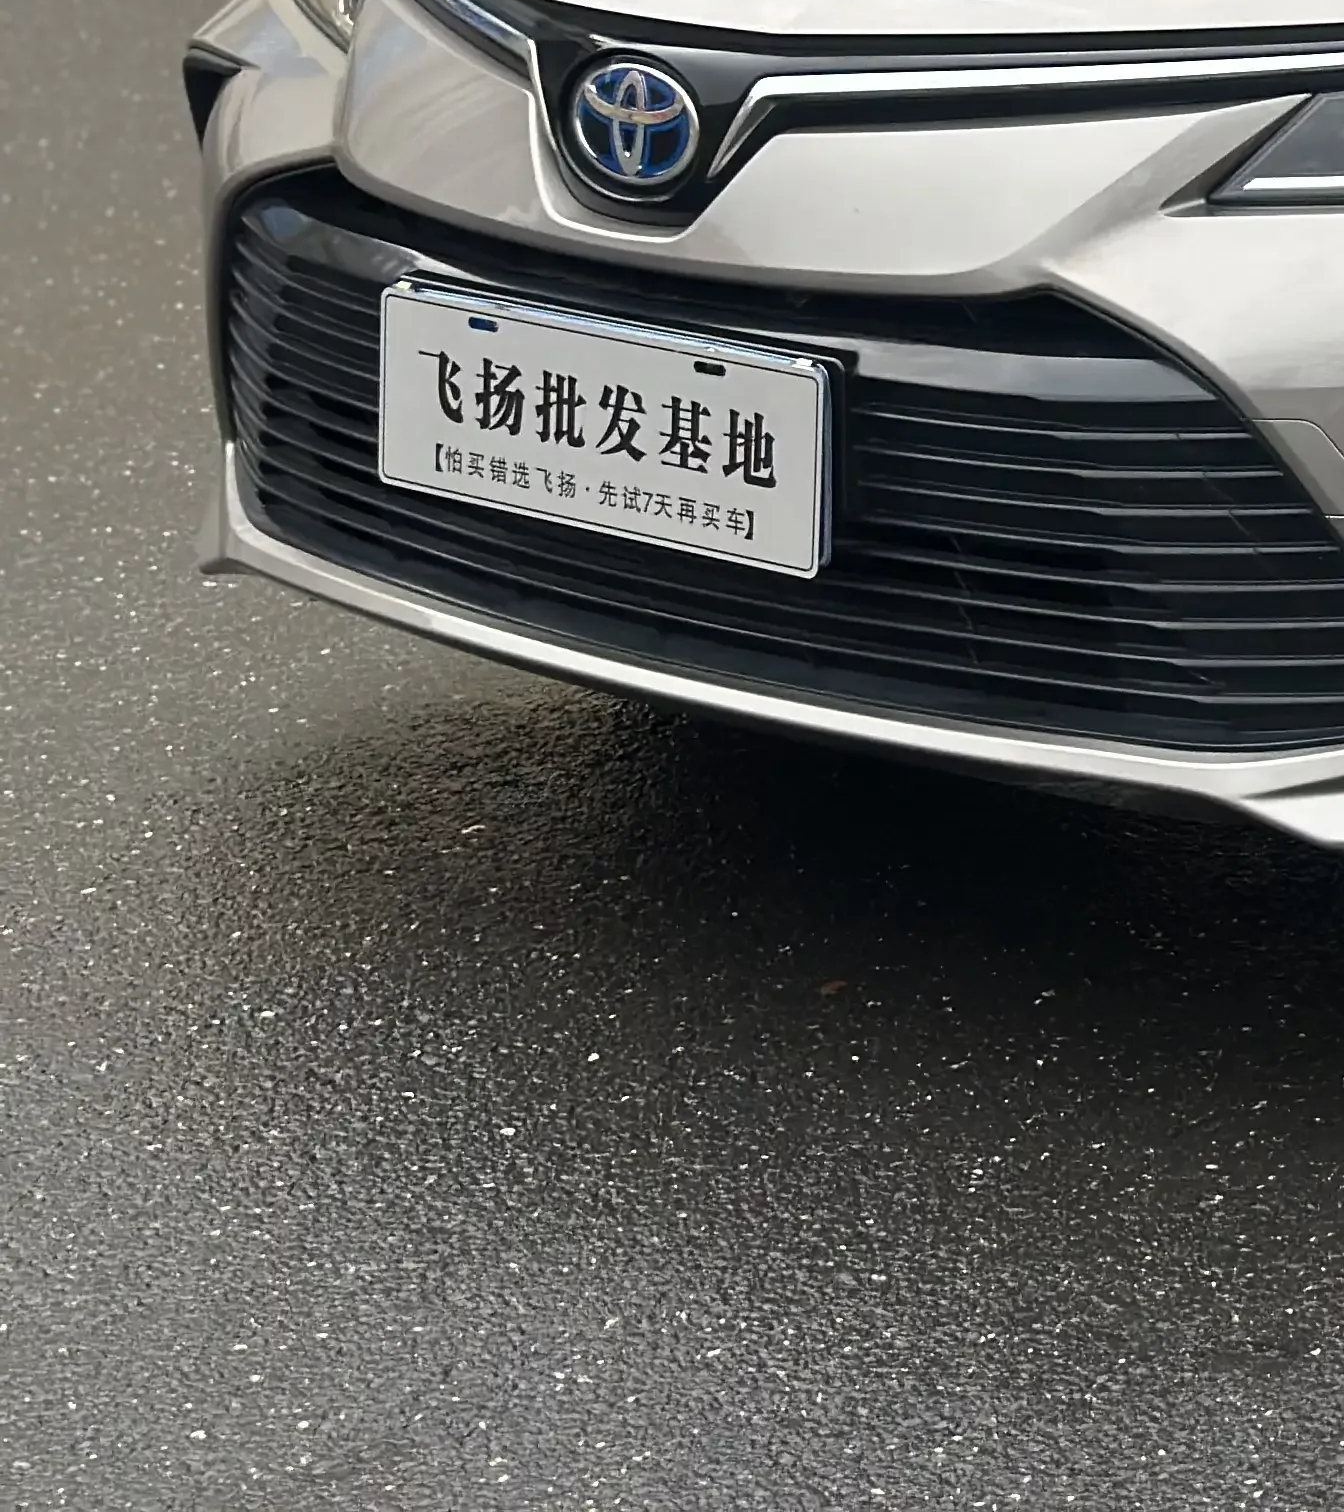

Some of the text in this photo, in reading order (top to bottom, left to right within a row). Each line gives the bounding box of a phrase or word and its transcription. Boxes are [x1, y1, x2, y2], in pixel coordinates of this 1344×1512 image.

[418, 349, 777, 489] 飞扬批发基地
